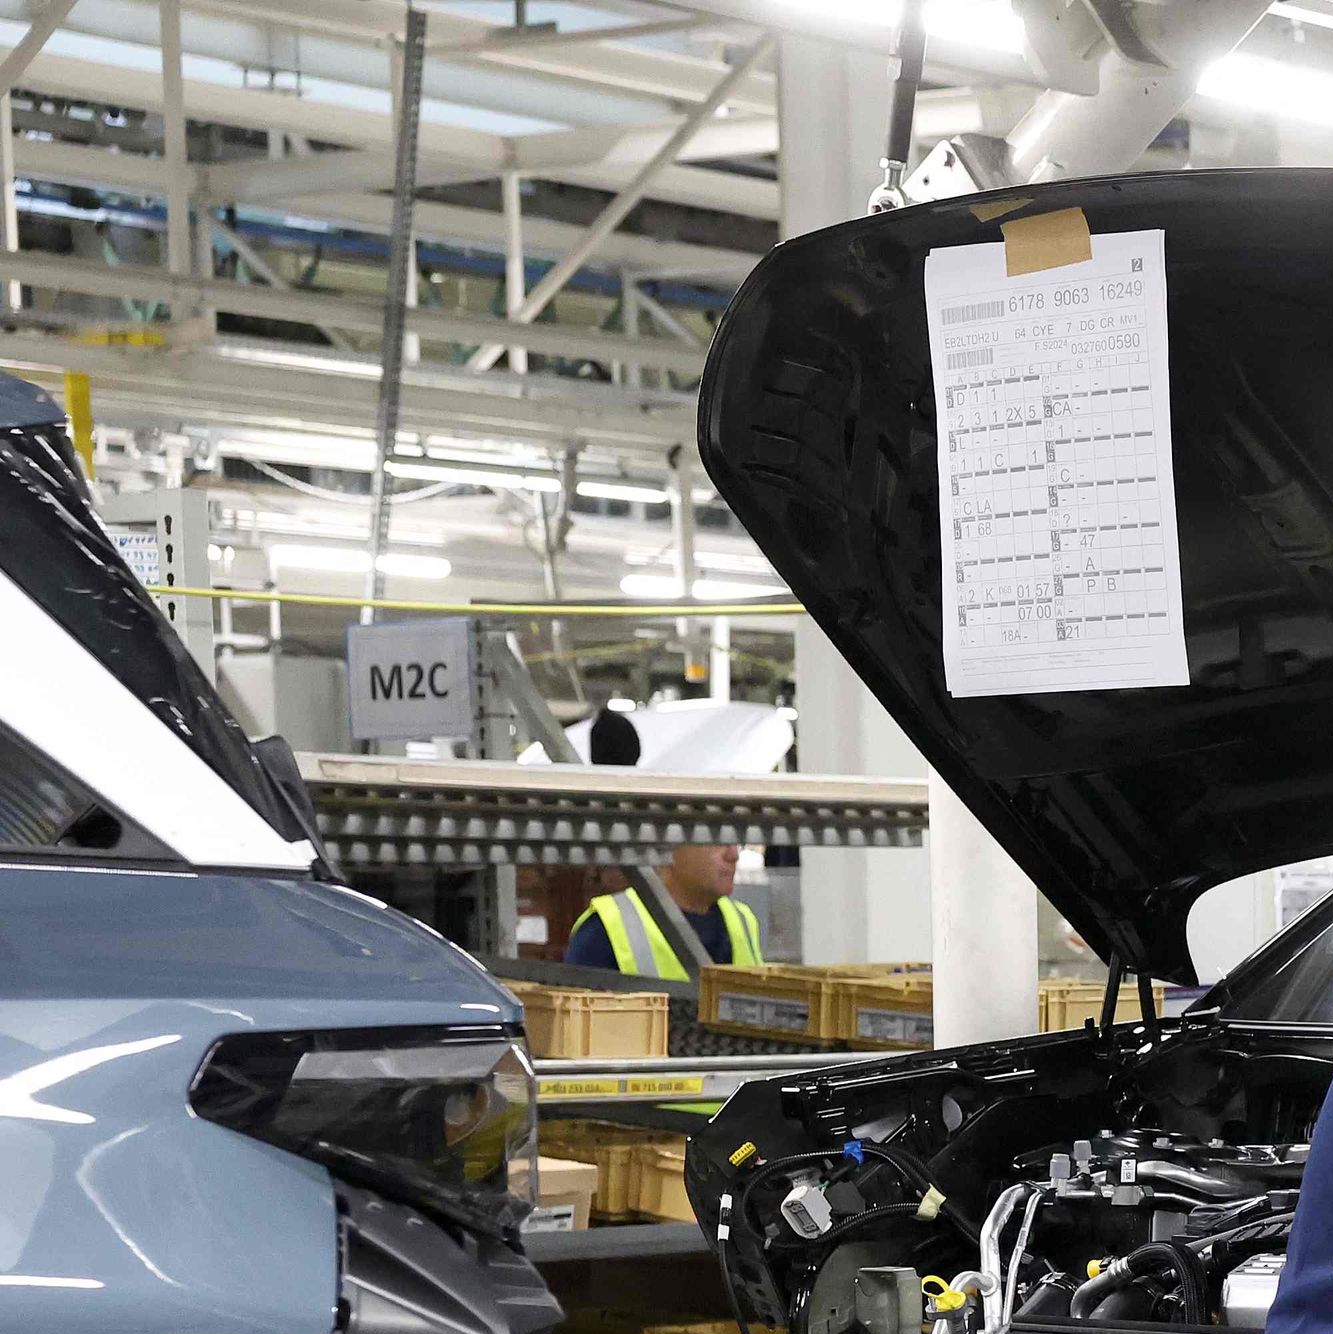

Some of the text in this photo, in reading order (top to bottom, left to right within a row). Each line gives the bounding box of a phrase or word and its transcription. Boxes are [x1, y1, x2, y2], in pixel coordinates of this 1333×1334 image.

[1009, 280, 1143, 313] 6178 9063 16249
[1033, 325, 1054, 336] CYE
[1066, 322, 1072, 333] 7
[1081, 320, 1095, 331] DG
[1100, 317, 1115, 328] CR
[1077, 360, 1083, 369] G
[1096, 357, 1102, 368] H
[957, 392, 965, 405] D
[1053, 401, 1072, 416] CA
[958, 415, 964, 428] 2
[974, 412, 981, 425] 3
[1006, 407, 1022, 421] 2X
[1029, 405, 1036, 418] 5
[960, 437, 966, 449] L
[995, 454, 1004, 467] C
[1061, 469, 1071, 482] C
[964, 502, 972, 515] C
[977, 500, 992, 514] LA
[978, 522, 992, 536] 68
[1080, 534, 1095, 548] 47
[1086, 557, 1095, 571] A
[1087, 579, 1096, 592] P
[1107, 578, 1116, 591] B
[969, 589, 975, 603] 2
[986, 588, 994, 600] K
[1017, 584, 1030, 598] 01
[1035, 583, 1050, 597] 57
[1018, 606, 1032, 620] 07
[1037, 605, 1051, 618] 00
[1065, 626, 1079, 639] 21
[369, 661, 449, 700] M2C
